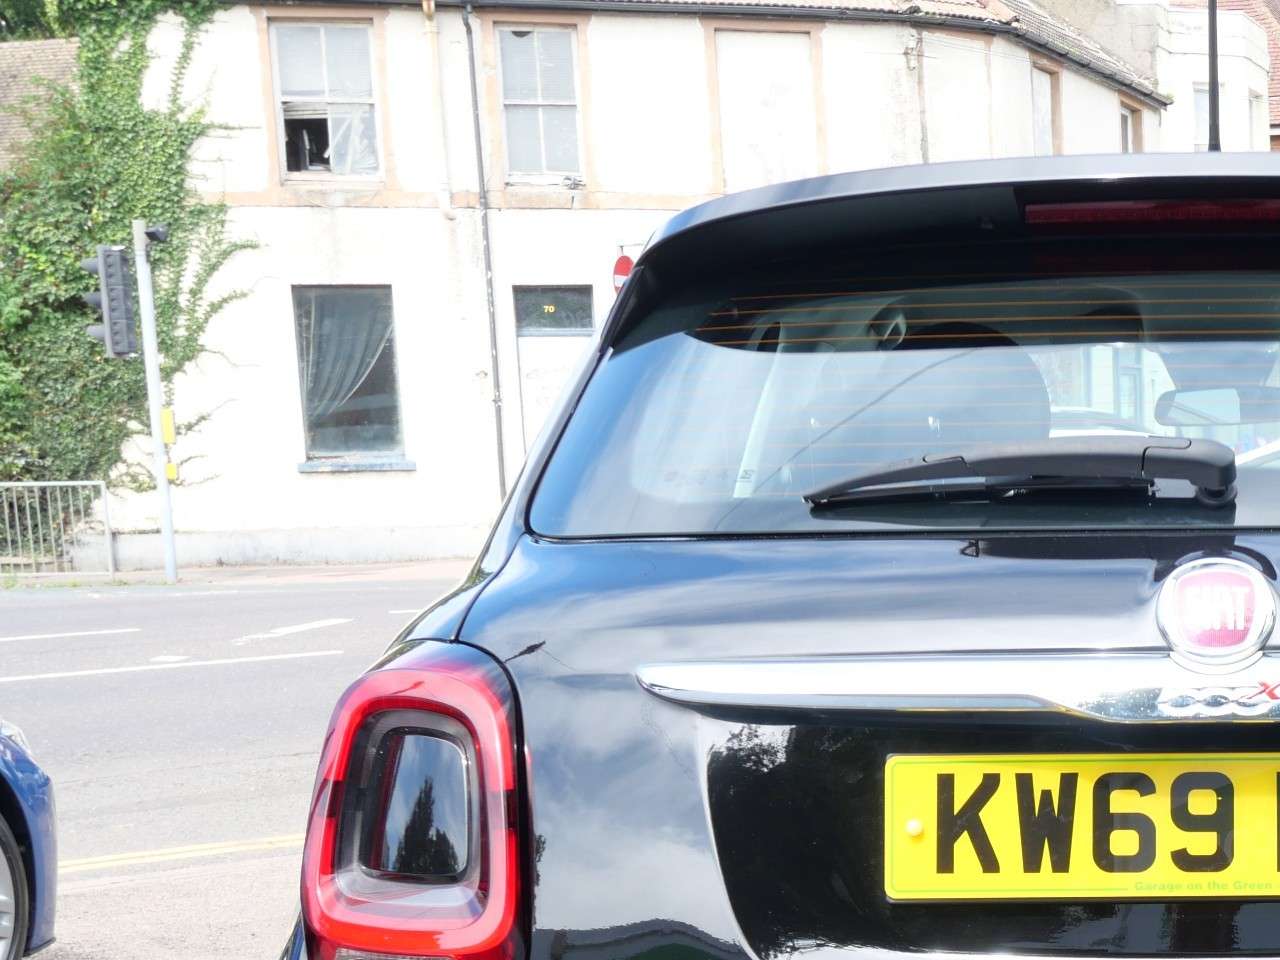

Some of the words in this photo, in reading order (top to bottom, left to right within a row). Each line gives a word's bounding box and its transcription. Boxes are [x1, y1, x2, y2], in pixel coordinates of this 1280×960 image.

[544, 305, 555, 313] 70
[936, 771, 1235, 874] KW69
[1134, 881, 1183, 892] Garage
[1187, 882, 1203, 890] on
[1207, 880, 1229, 890] the
[1232, 880, 1273, 890] Green
